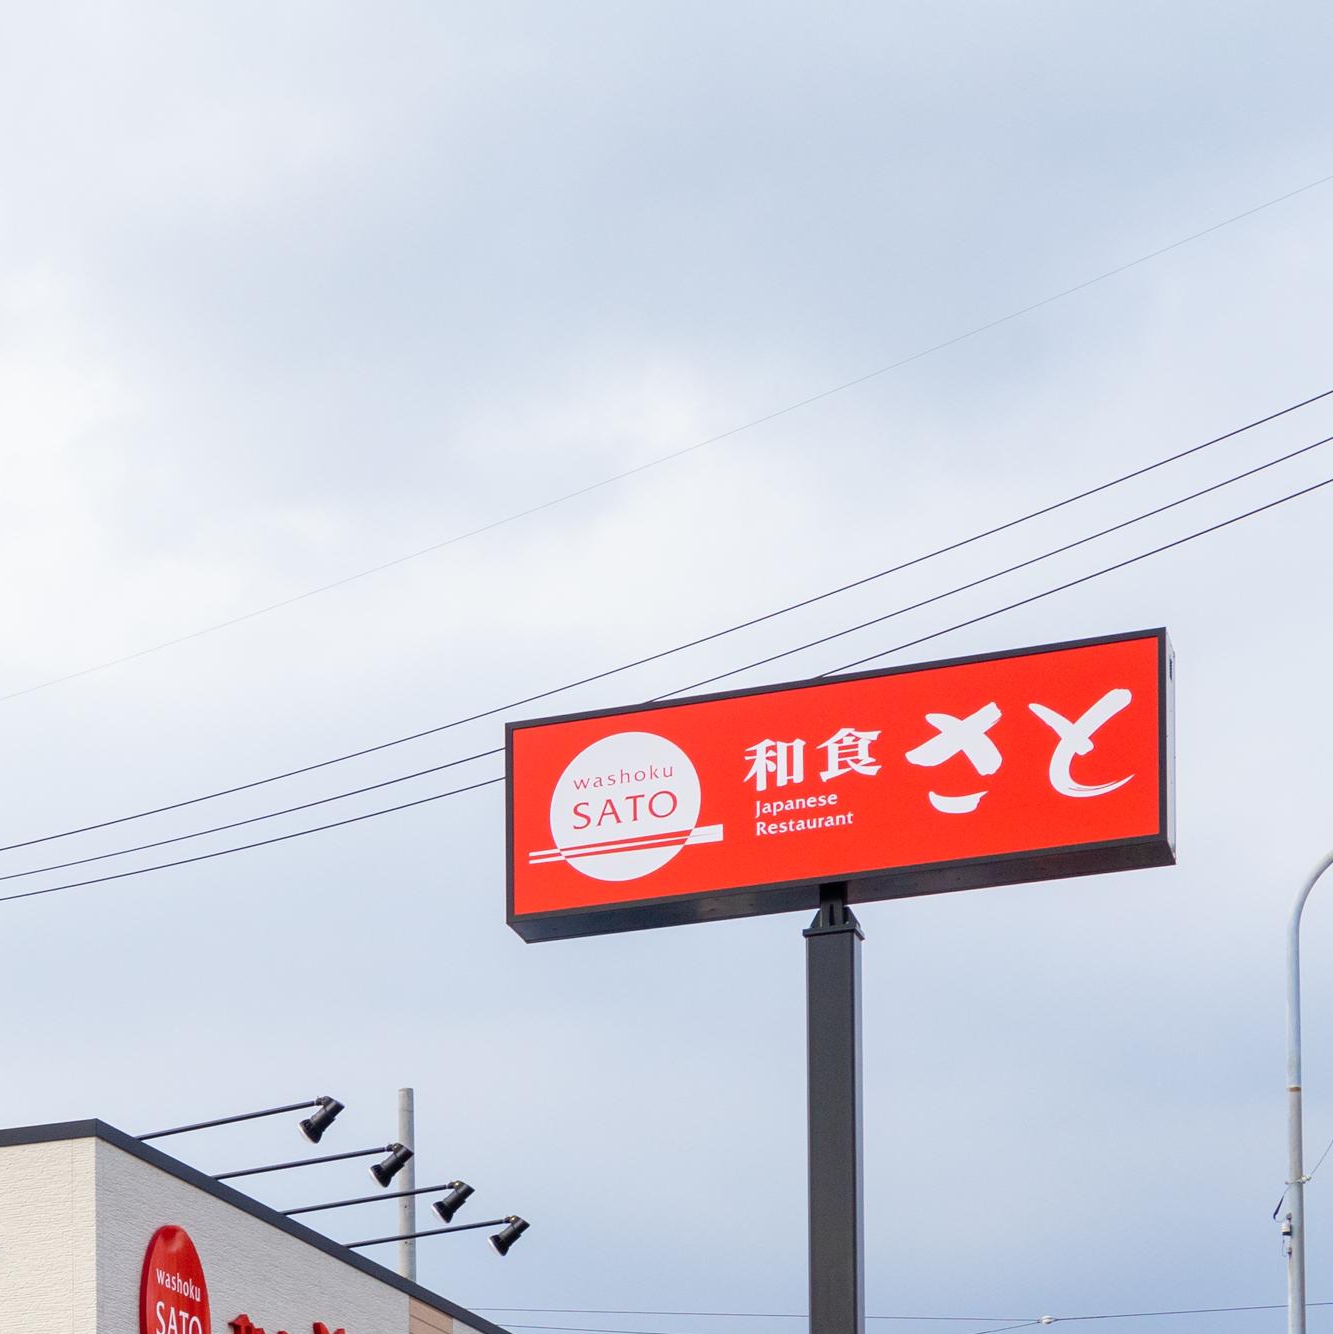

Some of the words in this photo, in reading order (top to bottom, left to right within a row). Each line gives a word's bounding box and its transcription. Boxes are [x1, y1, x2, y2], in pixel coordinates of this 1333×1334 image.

[573, 763, 674, 790] washoku
[572, 789, 678, 830] SATO
[755, 793, 838, 818] Japanese
[755, 811, 854, 836] Restaurant
[156, 1268, 201, 1303] washoku
